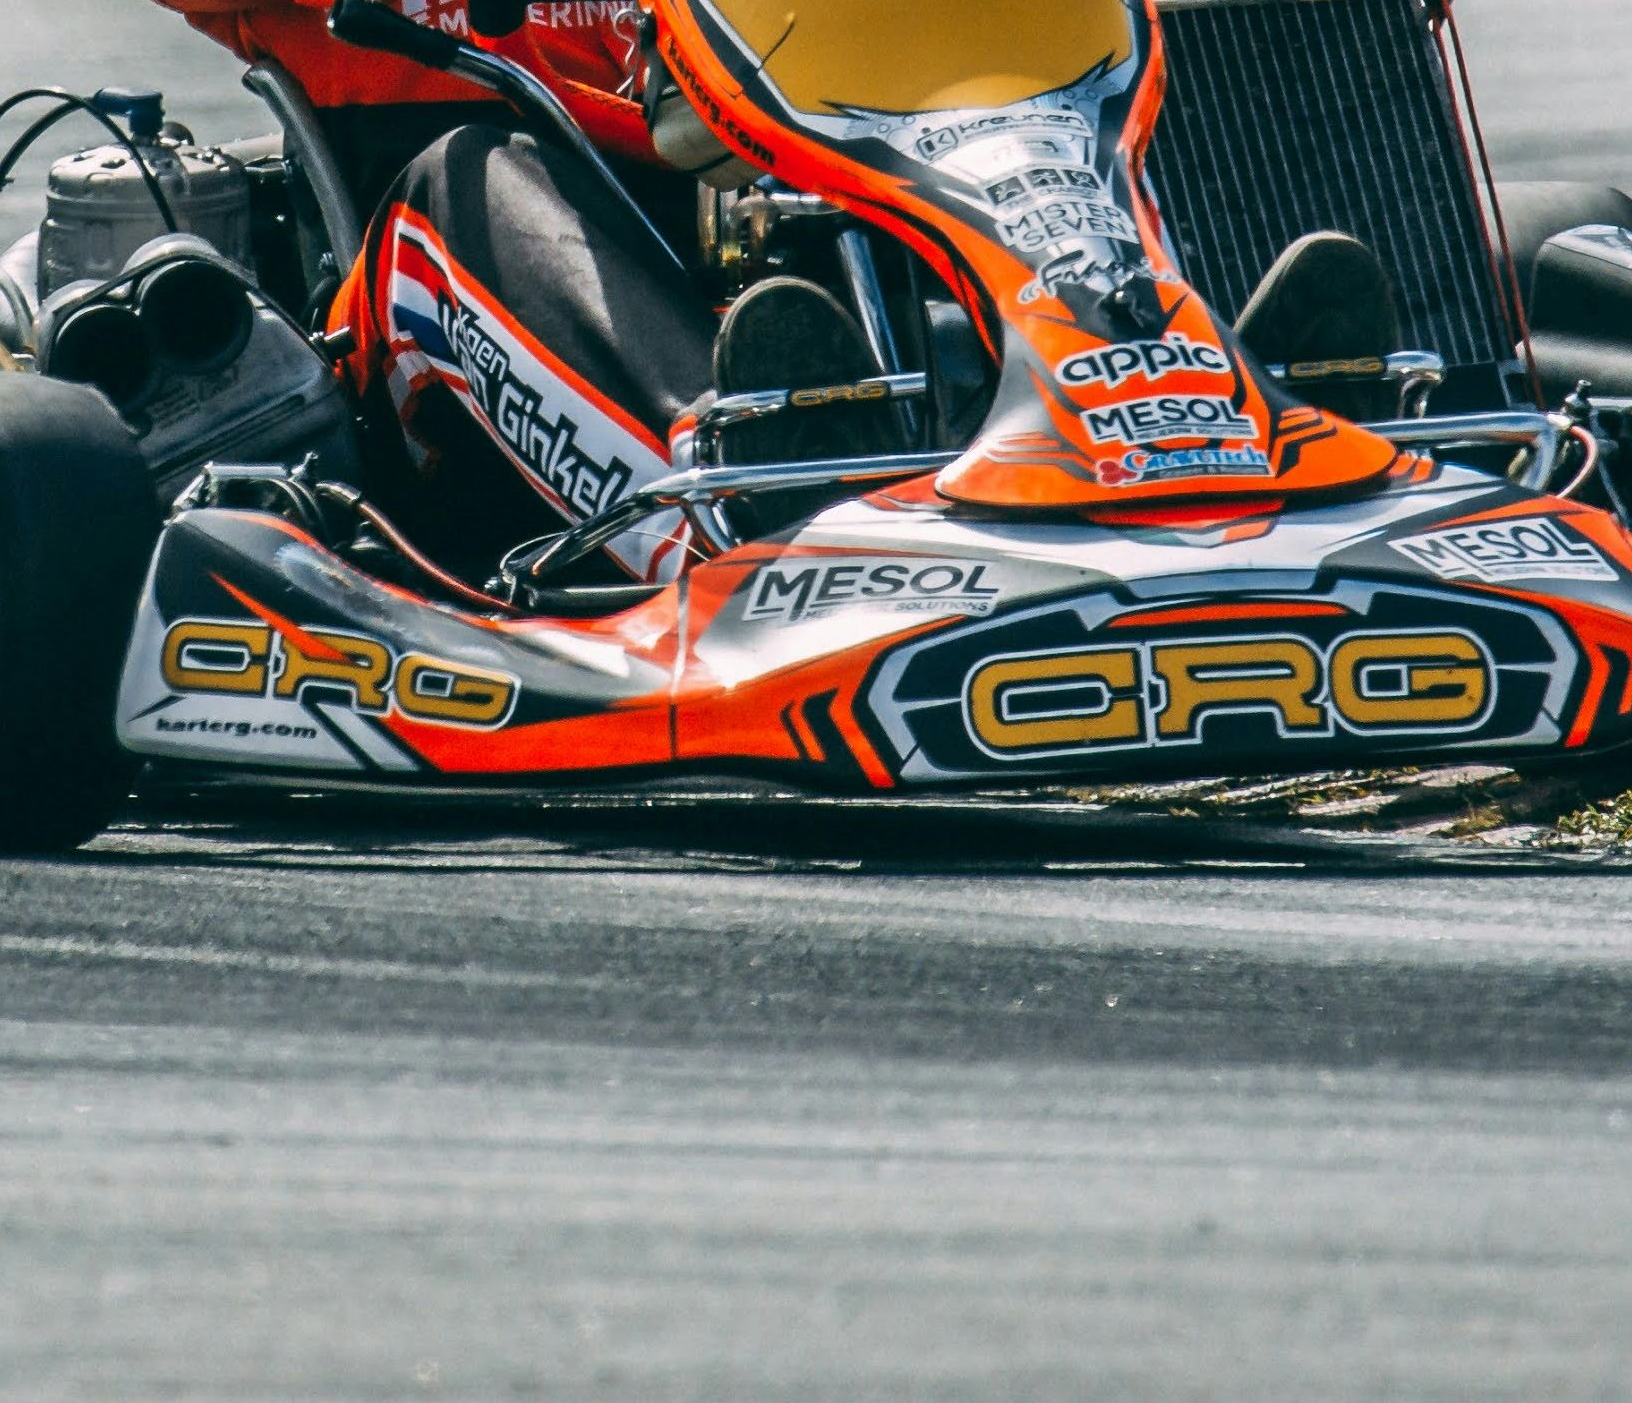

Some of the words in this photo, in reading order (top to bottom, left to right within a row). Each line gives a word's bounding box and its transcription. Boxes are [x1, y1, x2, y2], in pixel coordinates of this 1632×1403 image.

[1004, 201, 1122, 237] MISTER
[1022, 217, 1130, 248] SEVEN
[1062, 335, 1226, 383] appic
[791, 380, 888, 407] CRG
[1087, 397, 1250, 442] MESOL
[497, 382, 622, 516] Ginkel
[1399, 522, 1594, 577] MESOL
[755, 563, 1001, 623] MESOL
[894, 600, 989, 613] SOLUTIONS
[161, 620, 519, 729] CRG
[966, 631, 1492, 757] CRG
[156, 717, 317, 739] kartcrg.com
